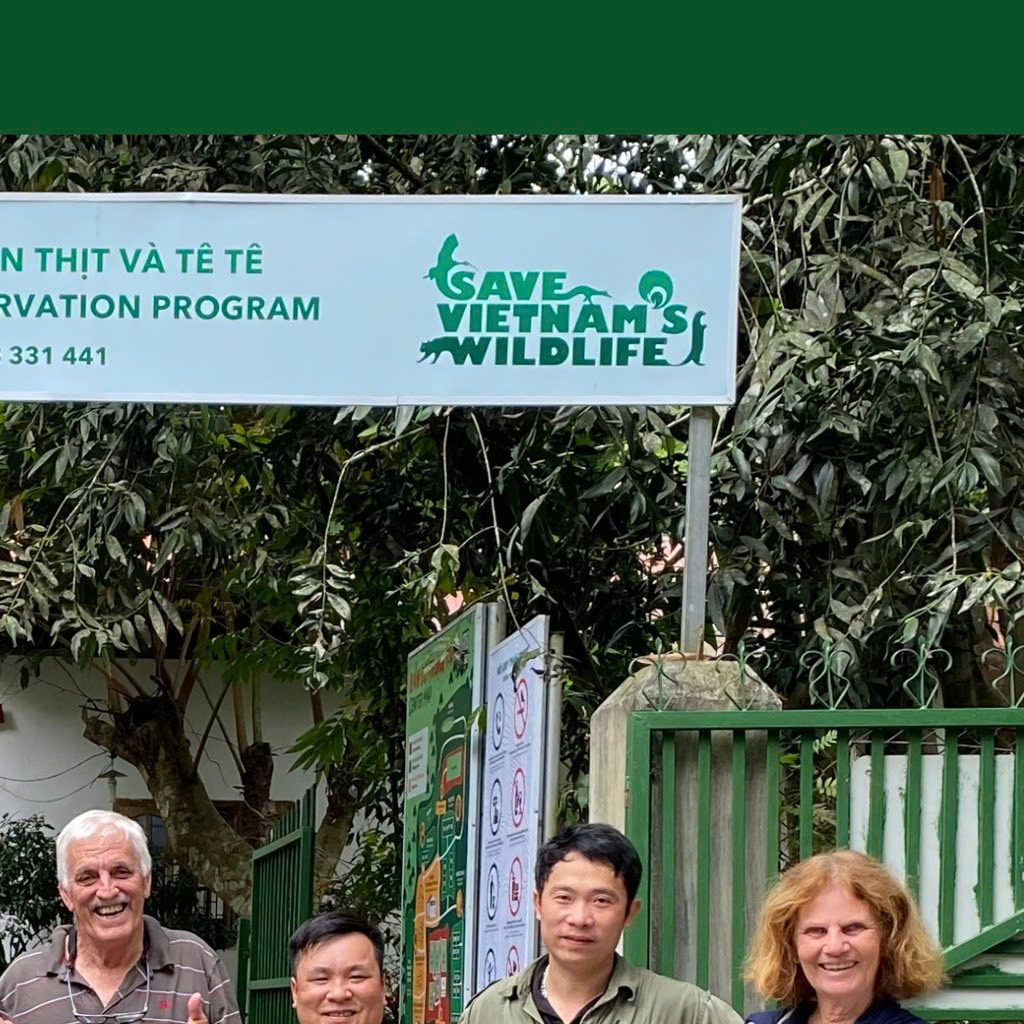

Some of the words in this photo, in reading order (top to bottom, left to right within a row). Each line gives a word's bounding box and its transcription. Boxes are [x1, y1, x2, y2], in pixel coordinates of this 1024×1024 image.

[34, 247, 110, 280] THỊT
[119, 242, 166, 273] VÀ
[175, 242, 213, 274] TÊ
[224, 243, 263, 275] TÊ
[437, 271, 568, 301] SAVE
[153, 295, 320, 321] PROGRAM
[437, 302, 688, 334] VIETNAM'S
[9, 345, 52, 365] 331
[62, 345, 105, 365] 441
[447, 336, 668, 366] WILDLIFE
